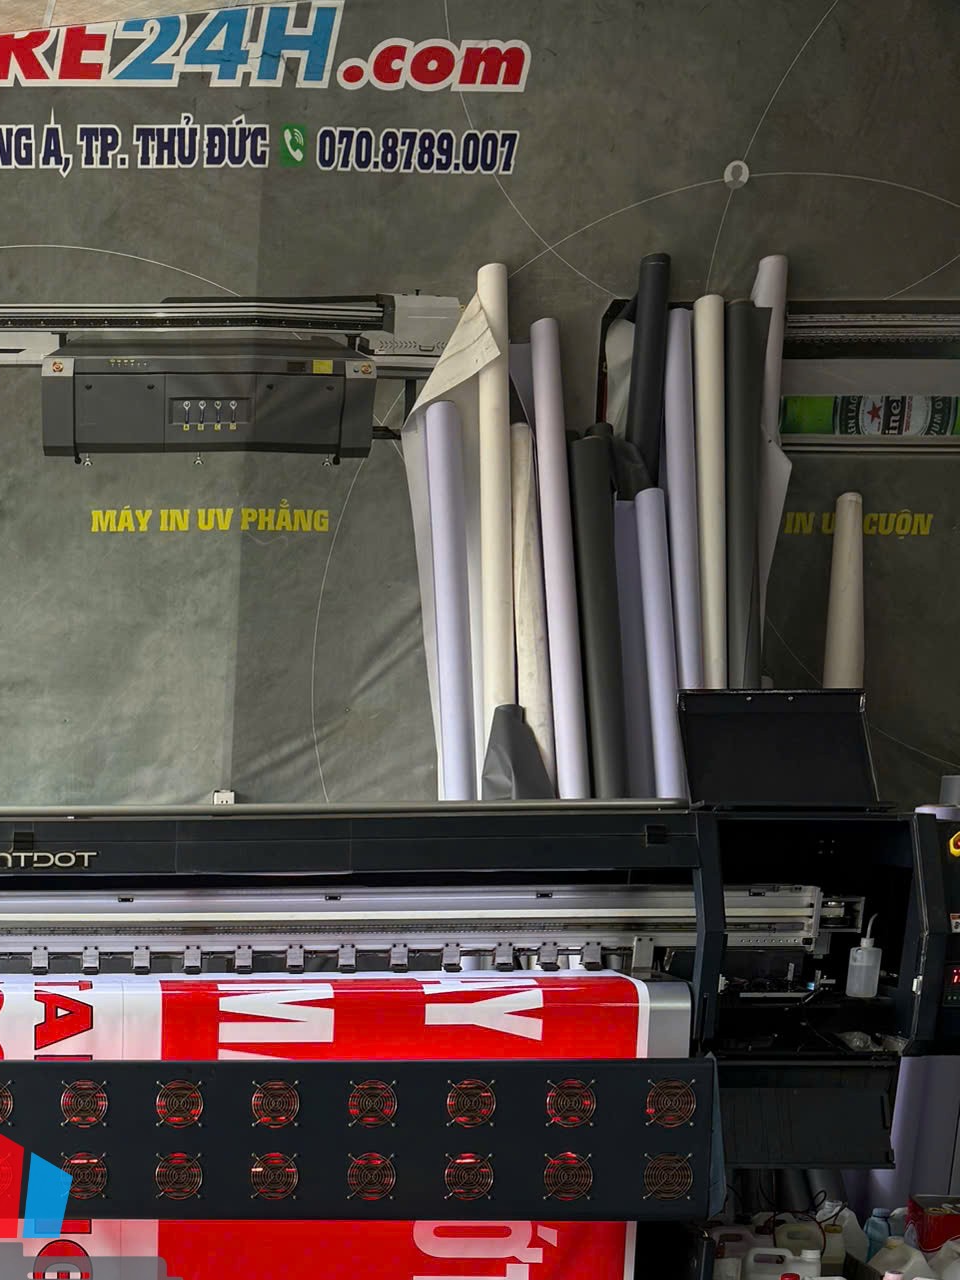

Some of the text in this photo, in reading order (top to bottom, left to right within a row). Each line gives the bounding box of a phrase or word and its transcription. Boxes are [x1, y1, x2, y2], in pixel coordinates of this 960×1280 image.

[76, 124, 129, 169] TP.
[133, 113, 199, 169] THỦ
[202, 113, 270, 169] ĐỨC
[316, 125, 520, 175] 070.8789.007
[91, 505, 153, 533] MÁY
[159, 508, 190, 532] IN
[197, 508, 234, 532] UV
[784, 508, 934, 540] IN U CUỘN
